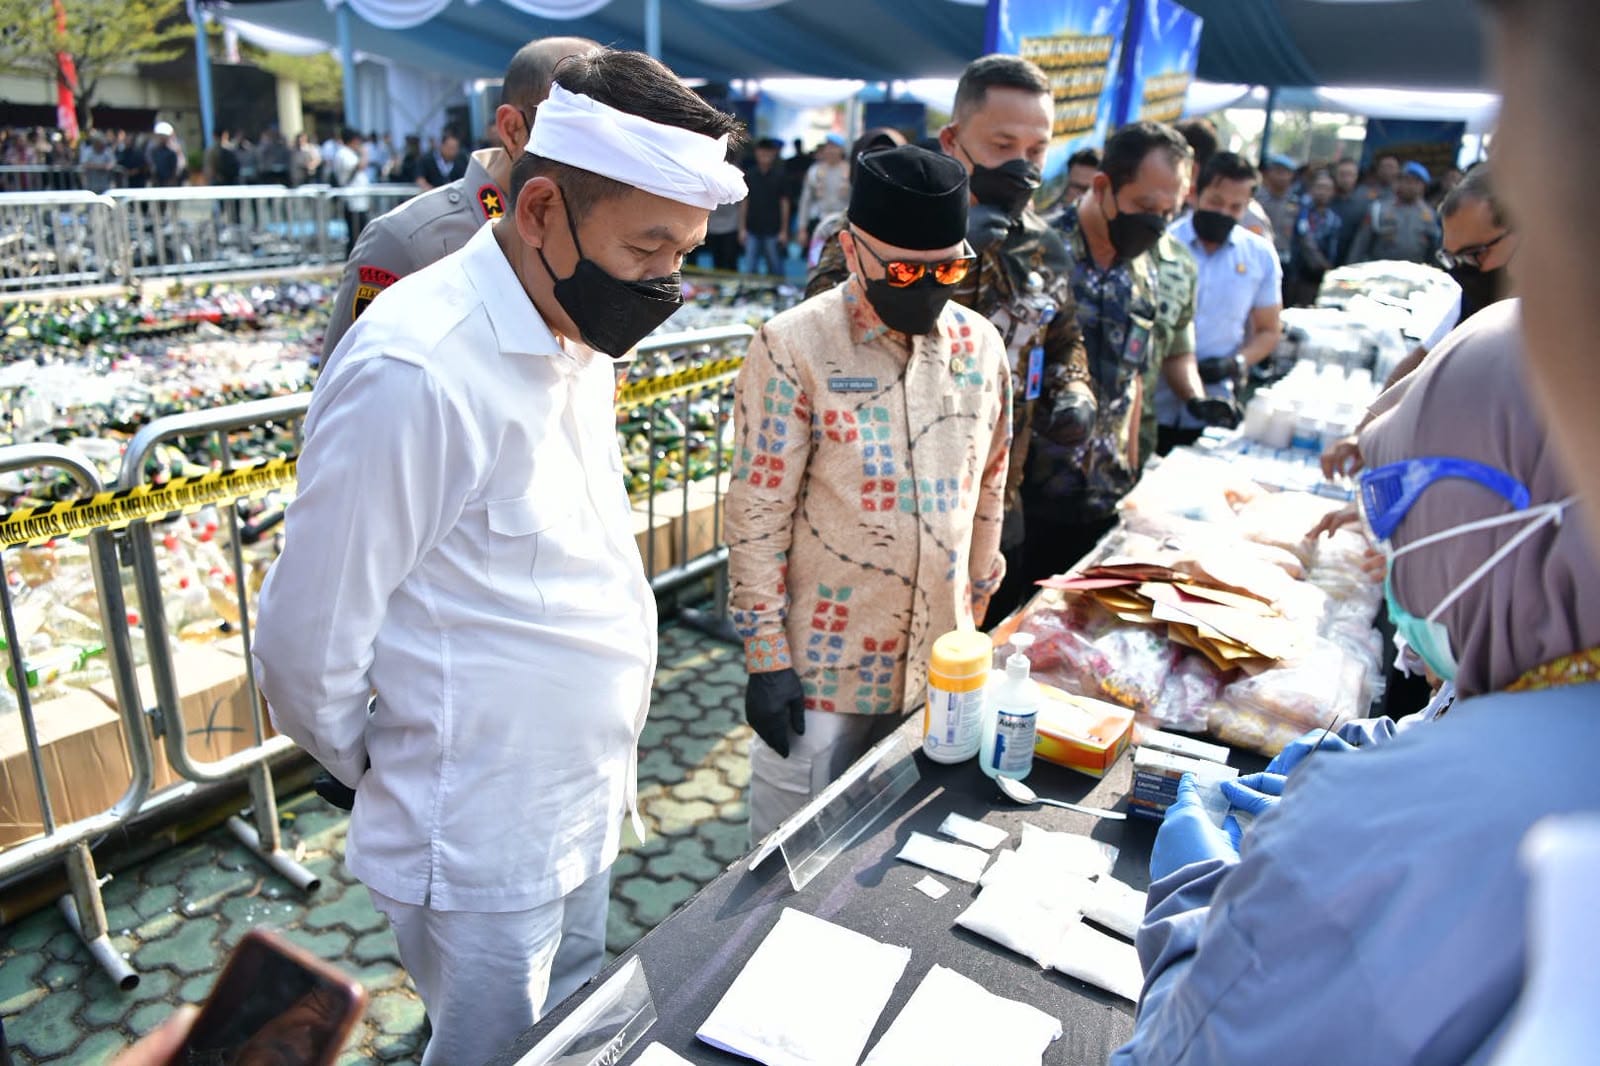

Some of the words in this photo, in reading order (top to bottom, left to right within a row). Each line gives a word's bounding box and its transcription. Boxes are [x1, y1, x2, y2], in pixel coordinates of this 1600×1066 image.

[0, 513, 58, 543] MELINTAS
[62, 502, 120, 531] DILARANG
[121, 491, 173, 520] MELINTAS
